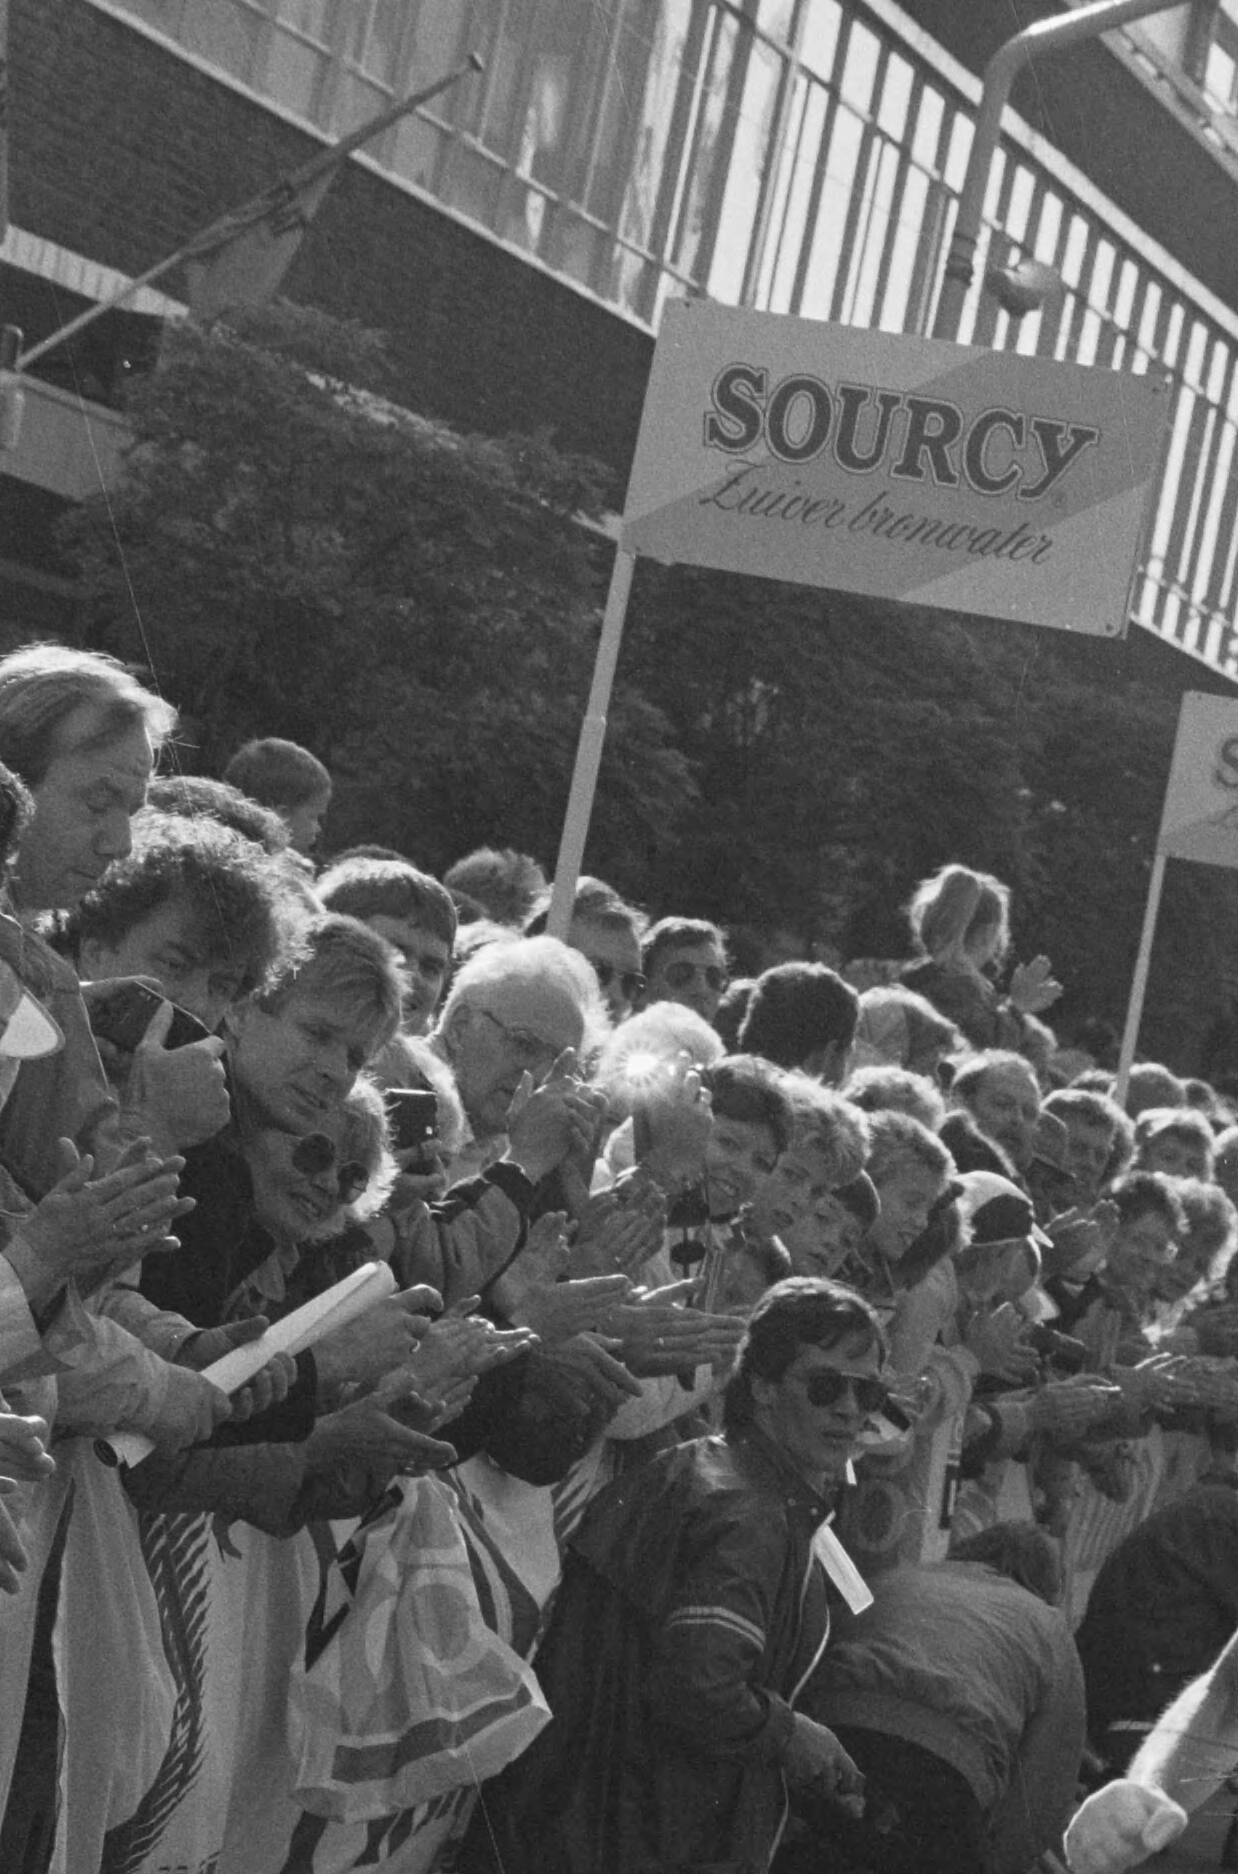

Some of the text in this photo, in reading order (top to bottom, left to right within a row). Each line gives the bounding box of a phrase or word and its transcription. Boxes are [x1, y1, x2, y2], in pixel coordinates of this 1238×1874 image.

[704, 363, 1098, 499] SOURCY
[700, 459, 1052, 564] Zuiver bronwater
